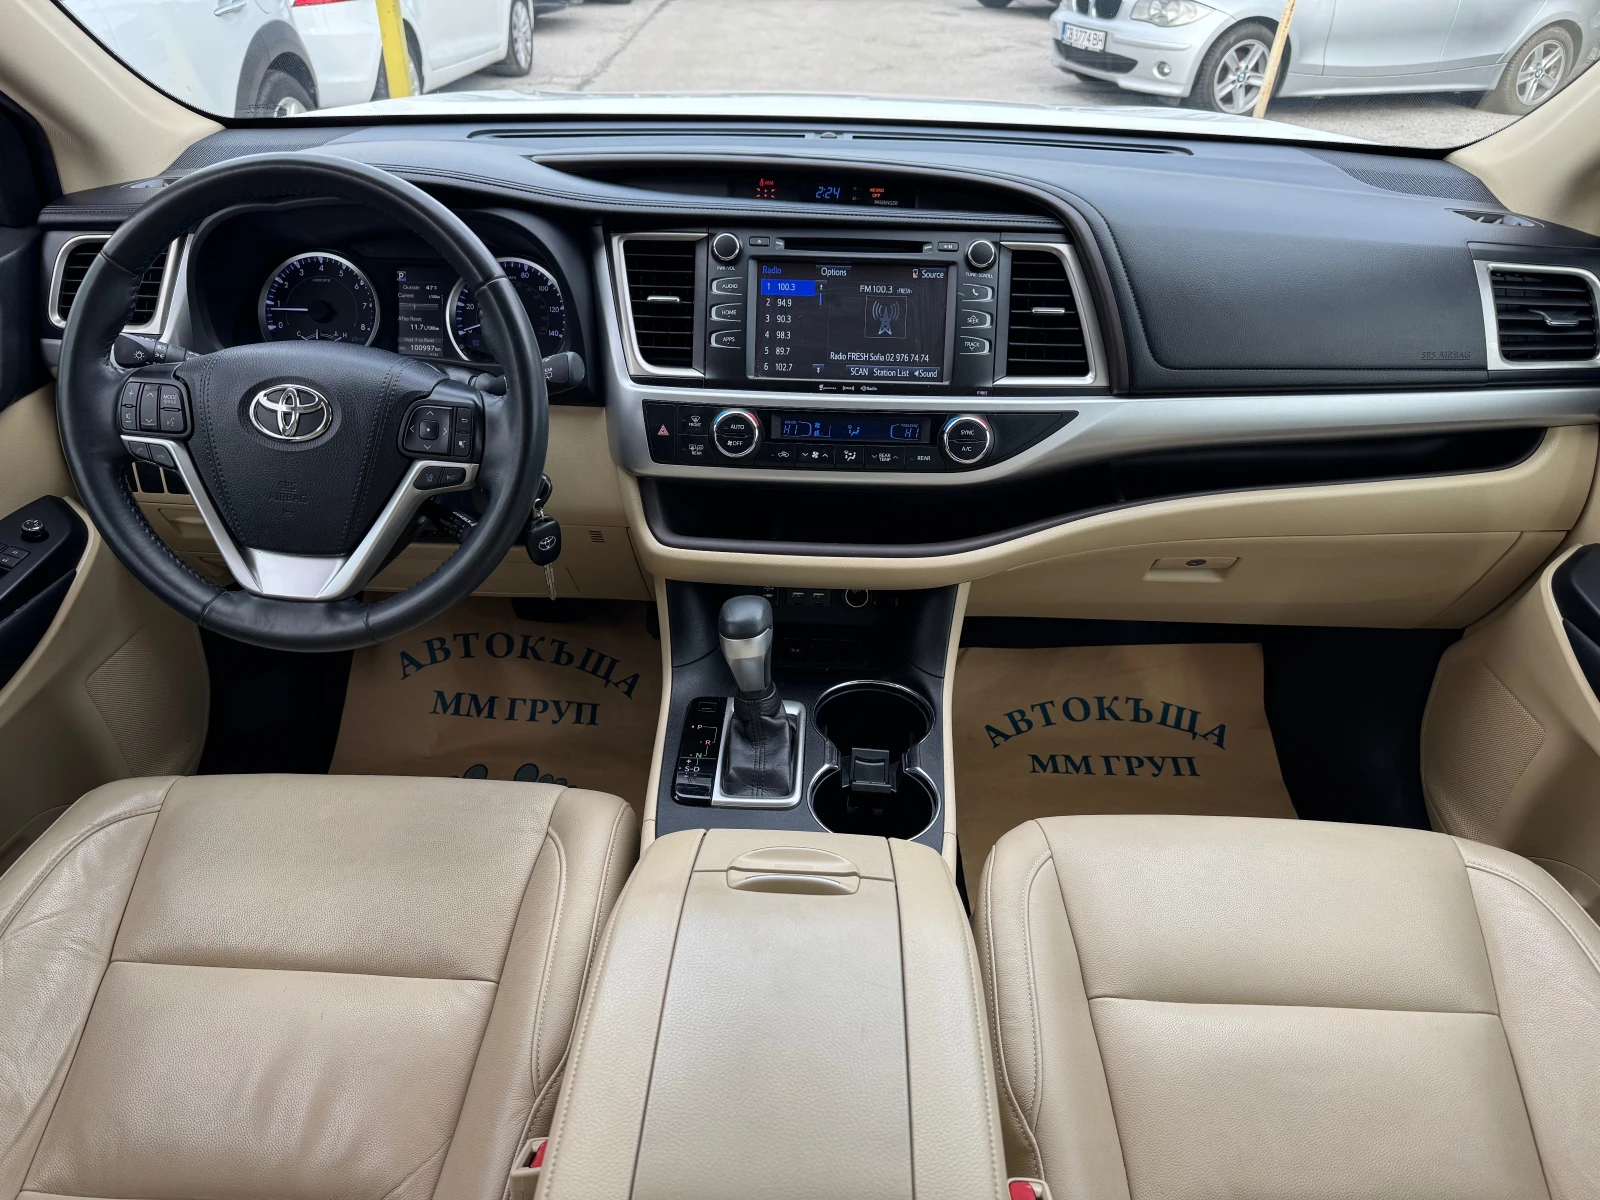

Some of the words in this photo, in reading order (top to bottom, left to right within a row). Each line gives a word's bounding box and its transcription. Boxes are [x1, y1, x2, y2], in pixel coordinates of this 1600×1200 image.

[816, 187, 841, 199] 2:24
[762, 265, 782, 274] Radio
[820, 268, 847, 277] Options
[921, 269, 945, 278] Source
[398, 272, 404, 280] P
[778, 283, 796, 291] 100.3
[766, 298, 770, 306] 2
[777, 298, 792, 307] 94.9
[765, 314, 770, 322] 3
[776, 314, 792, 323] 90.3
[764, 330, 770, 338] 4
[776, 331, 791, 340] 98.3
[764, 346, 769, 354] 5
[775, 347, 790, 356] 89.7
[1440, 350, 1470, 359] AIRBAG
[830, 352, 846, 360] Radio
[848, 352, 869, 361] FRESH
[870, 352, 884, 361] Sofia
[886, 353, 894, 362] 02
[896, 354, 908, 362] 976
[910, 354, 919, 362] 74
[920, 354, 930, 362] 74
[764, 362, 768, 371] 6
[775, 363, 793, 372] 102.7
[850, 368, 869, 376] SCAN
[873, 368, 896, 377] Station
[898, 368, 910, 378] List
[919, 369, 938, 378] Sound
[400, 632, 641, 699] АВТОКЪЩА
[429, 690, 499, 720] ММ
[504, 698, 600, 726] ГРУП
[984, 696, 1227, 750] АВТОКЪЩА
[1028, 754, 1096, 776] ММ
[1100, 755, 1201, 778] ГРУП
